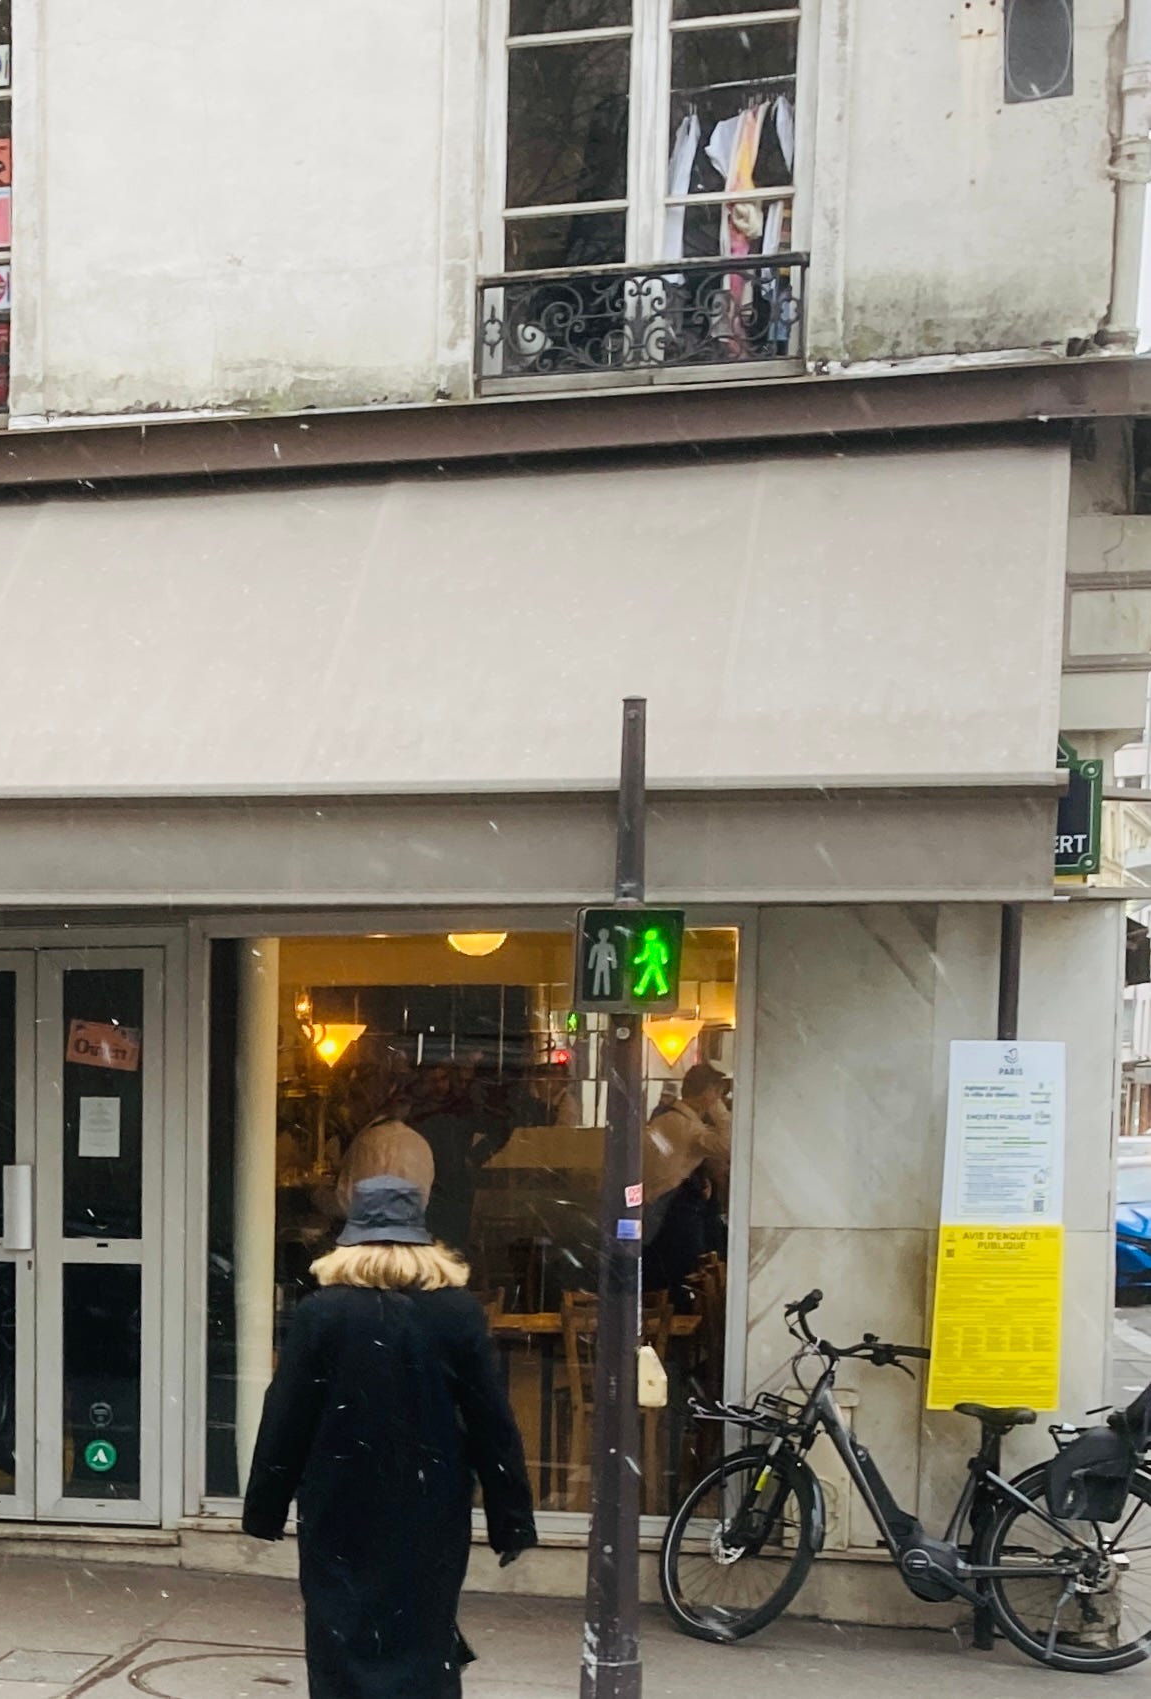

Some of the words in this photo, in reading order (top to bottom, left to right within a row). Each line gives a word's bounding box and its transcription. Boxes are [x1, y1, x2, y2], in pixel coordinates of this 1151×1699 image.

[998, 1067, 1023, 1076] PARIS
[962, 1231, 985, 1241] AVIS
[977, 1241, 1026, 1250] PUBLIQUE
